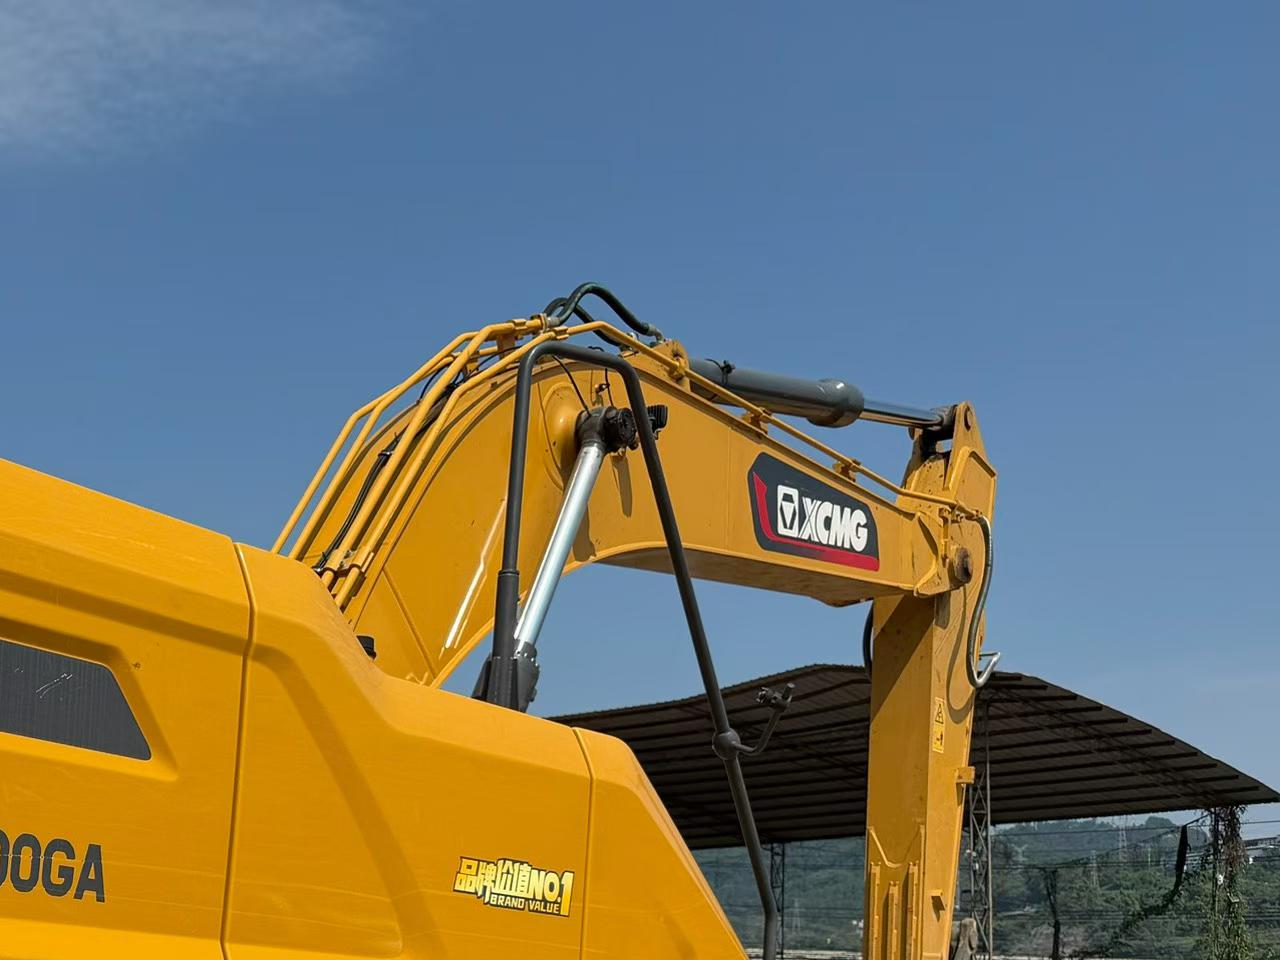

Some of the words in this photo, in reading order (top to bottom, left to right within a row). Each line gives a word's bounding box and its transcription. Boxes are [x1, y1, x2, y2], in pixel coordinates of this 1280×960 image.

[799, 496, 868, 552] XCMG
[490, 894, 526, 909] BRAND
[529, 900, 560, 914] VALUE
